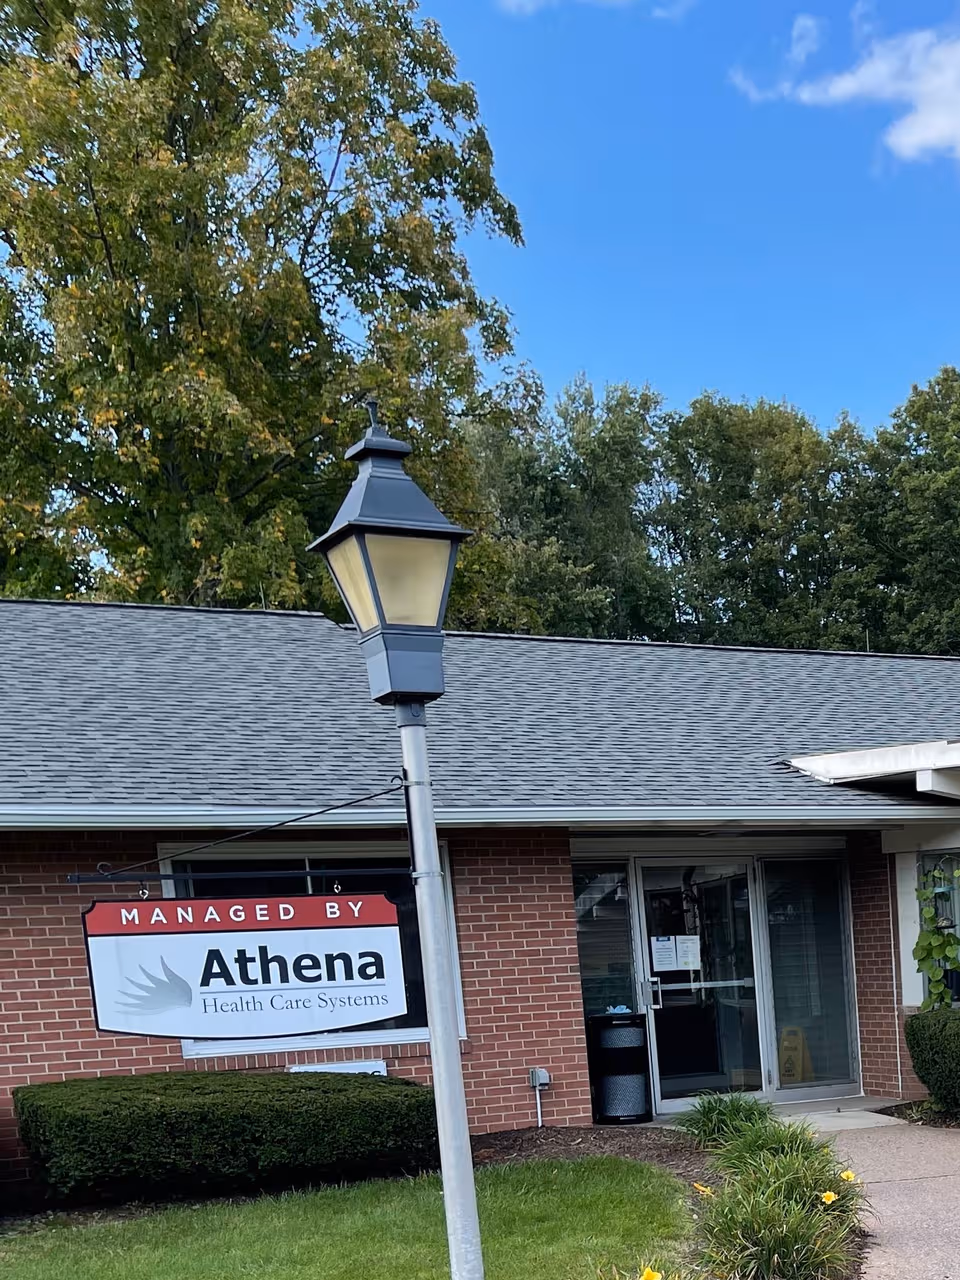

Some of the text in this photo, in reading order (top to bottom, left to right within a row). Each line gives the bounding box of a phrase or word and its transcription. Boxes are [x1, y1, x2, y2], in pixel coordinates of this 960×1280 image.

[120, 901, 363, 925] MANAGED BY
[200, 945, 385, 987] Athena
[202, 992, 389, 1014] Health Care Systems
